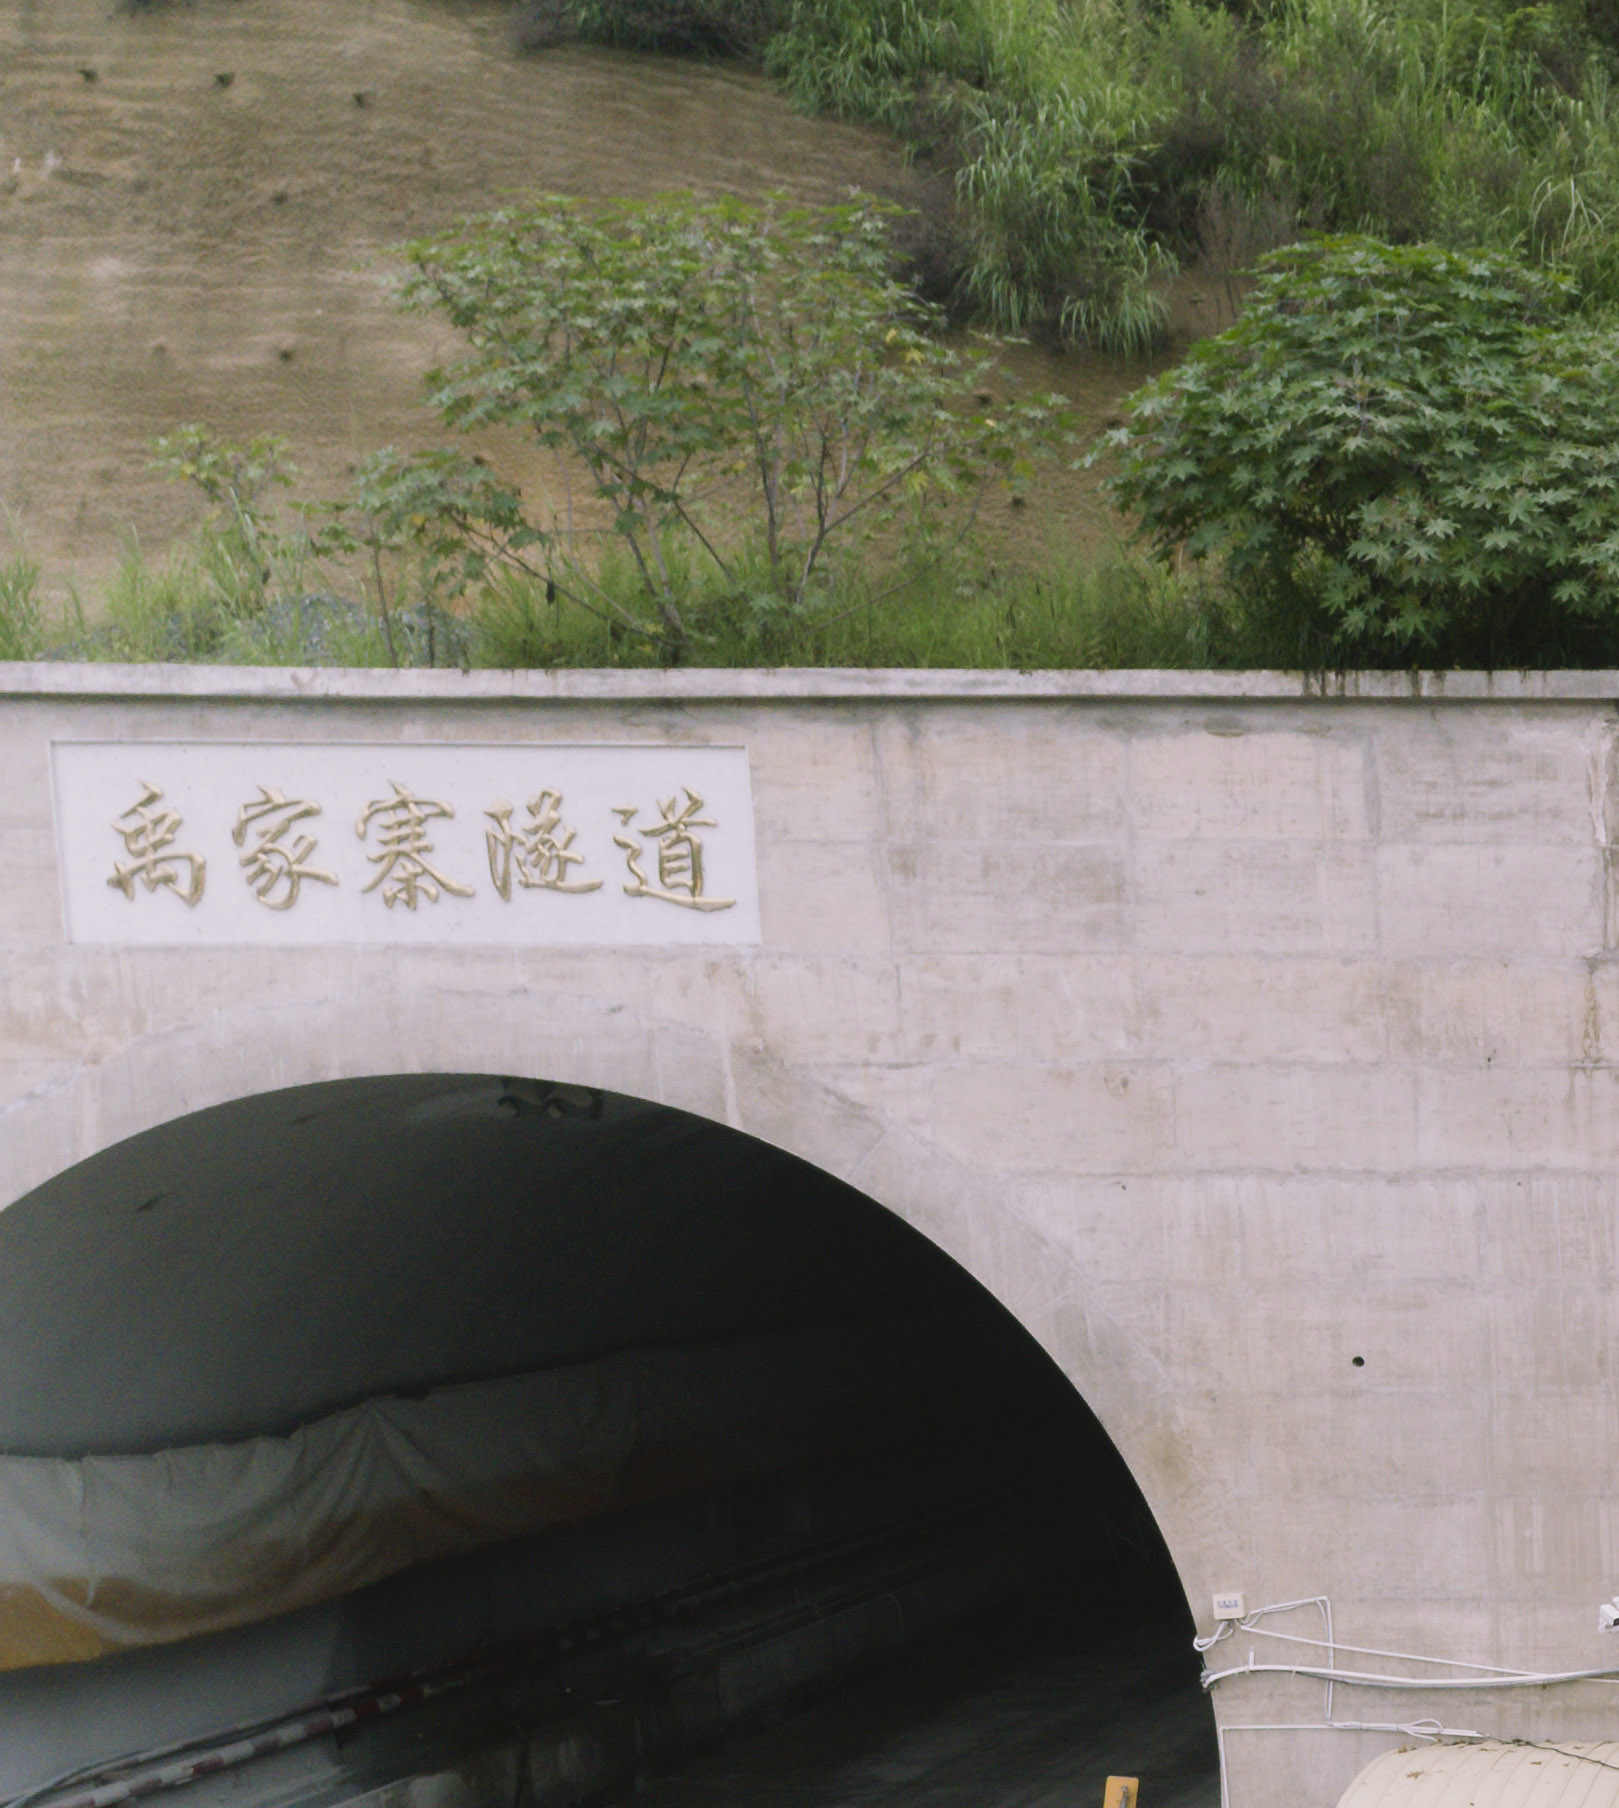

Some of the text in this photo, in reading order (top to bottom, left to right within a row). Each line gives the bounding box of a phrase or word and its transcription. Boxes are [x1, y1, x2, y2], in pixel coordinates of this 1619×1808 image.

[106, 780, 737, 912] 禹家寨隧道
